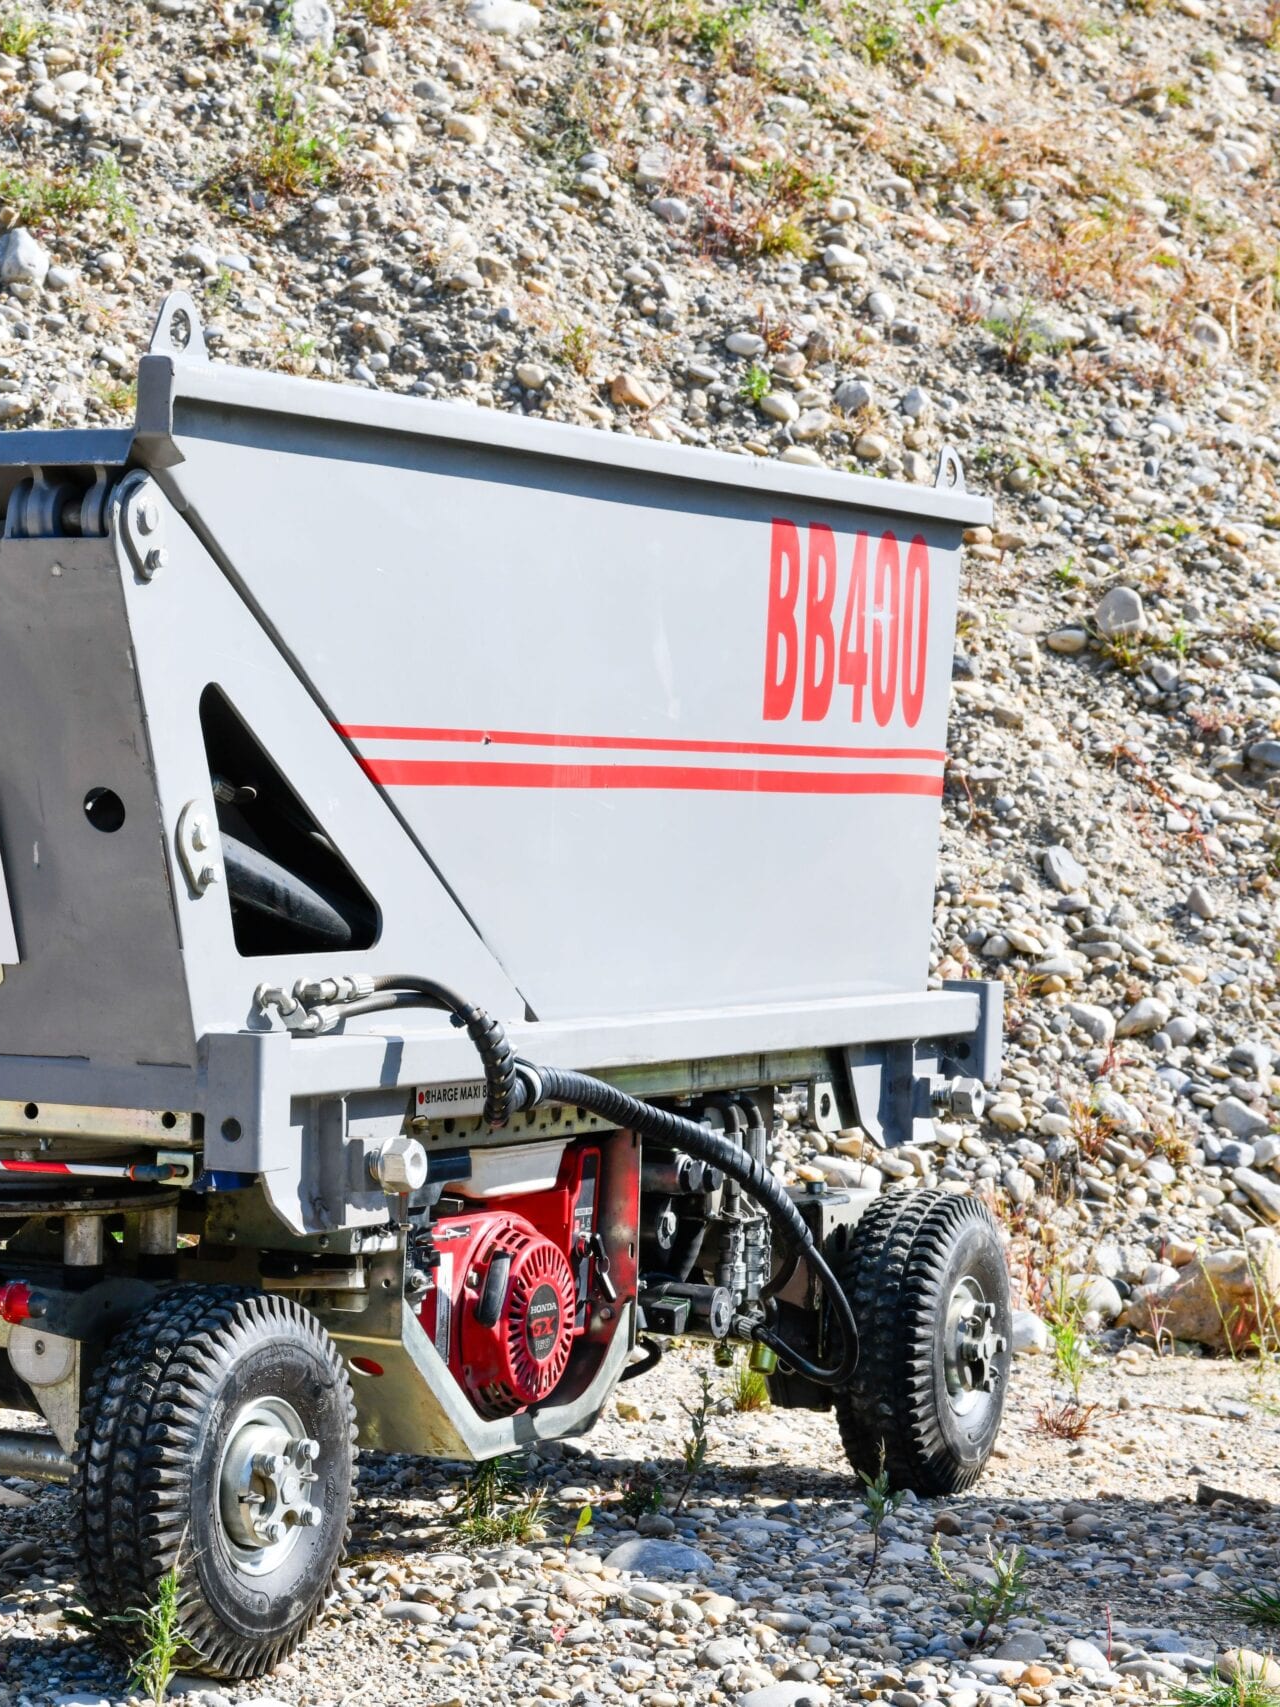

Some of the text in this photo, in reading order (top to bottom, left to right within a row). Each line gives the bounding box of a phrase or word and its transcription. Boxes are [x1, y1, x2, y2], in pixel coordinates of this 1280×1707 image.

[763, 517, 930, 728] BB400
[424, 1087, 458, 1104] CHARGE
[460, 1085, 481, 1101] MAXI
[530, 1302, 557, 1314] HONDA
[531, 1316, 556, 1337] GX
